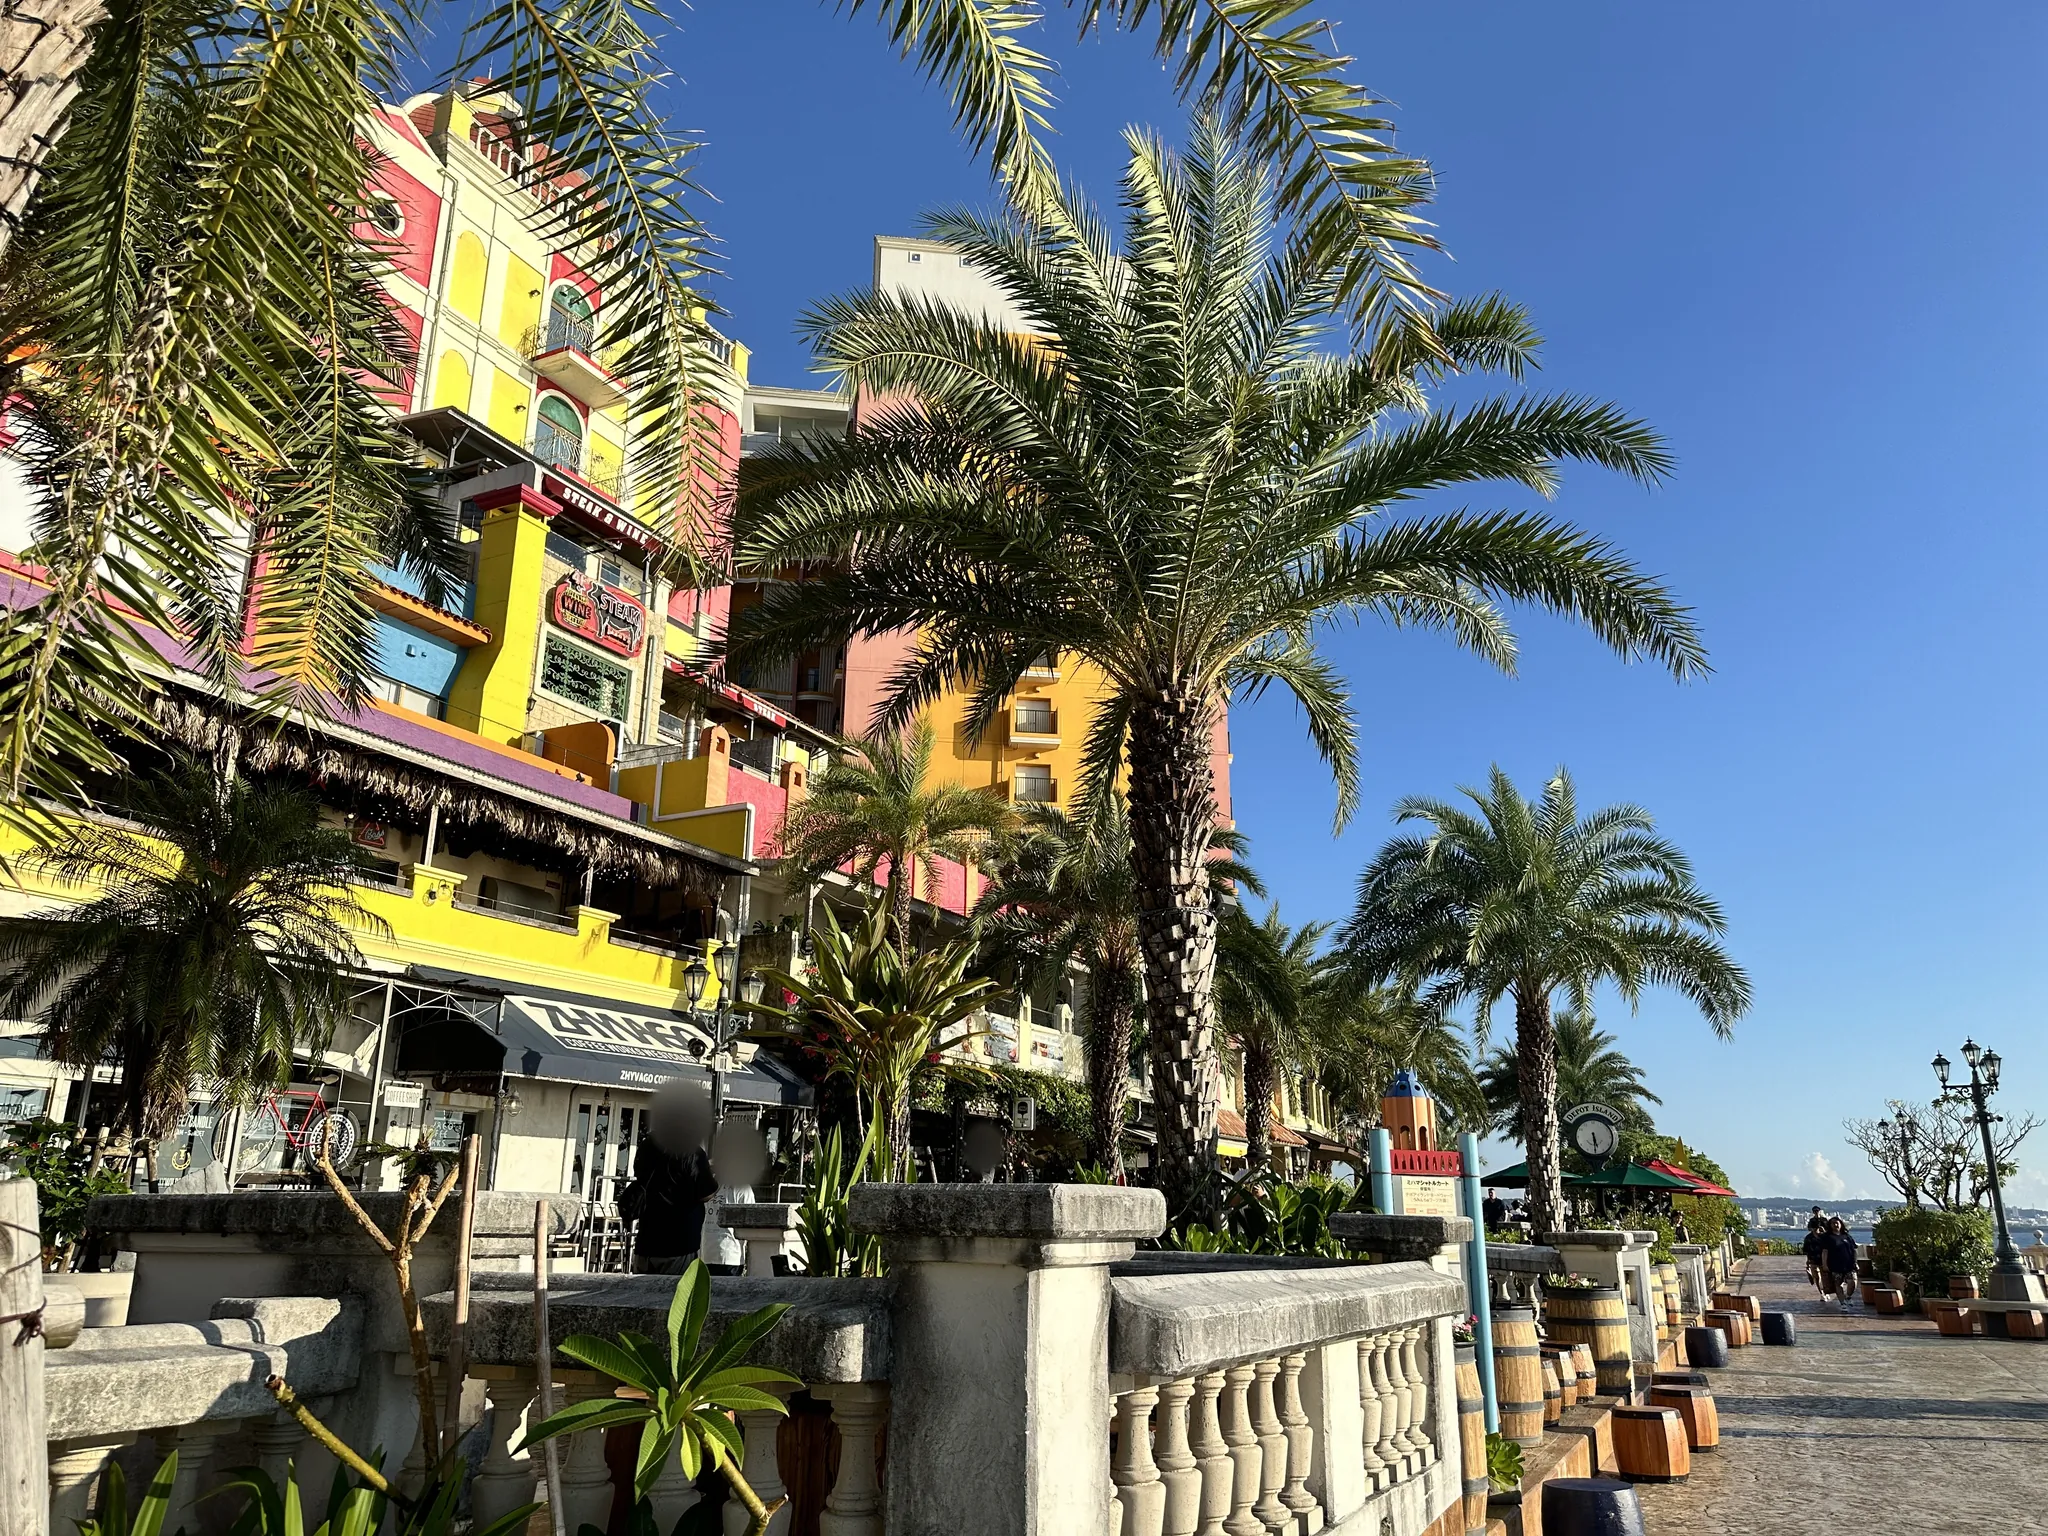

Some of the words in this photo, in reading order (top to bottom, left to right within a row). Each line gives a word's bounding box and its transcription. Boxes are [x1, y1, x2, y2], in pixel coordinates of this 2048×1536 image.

[562, 487, 603, 518] STEAK
[603, 513, 614, 525] &
[615, 516, 649, 545] WINE
[562, 595, 592, 619] WINE
[600, 593, 641, 626] STEAK
[522, 1000, 697, 1050] ZHYVAGO
[564, 1037, 610, 1051] COFFEE
[619, 1069, 654, 1084] ZHYVAGO
[1566, 1105, 1590, 1121] DEPOT
[1592, 1104, 1619, 1122] ISLAND
